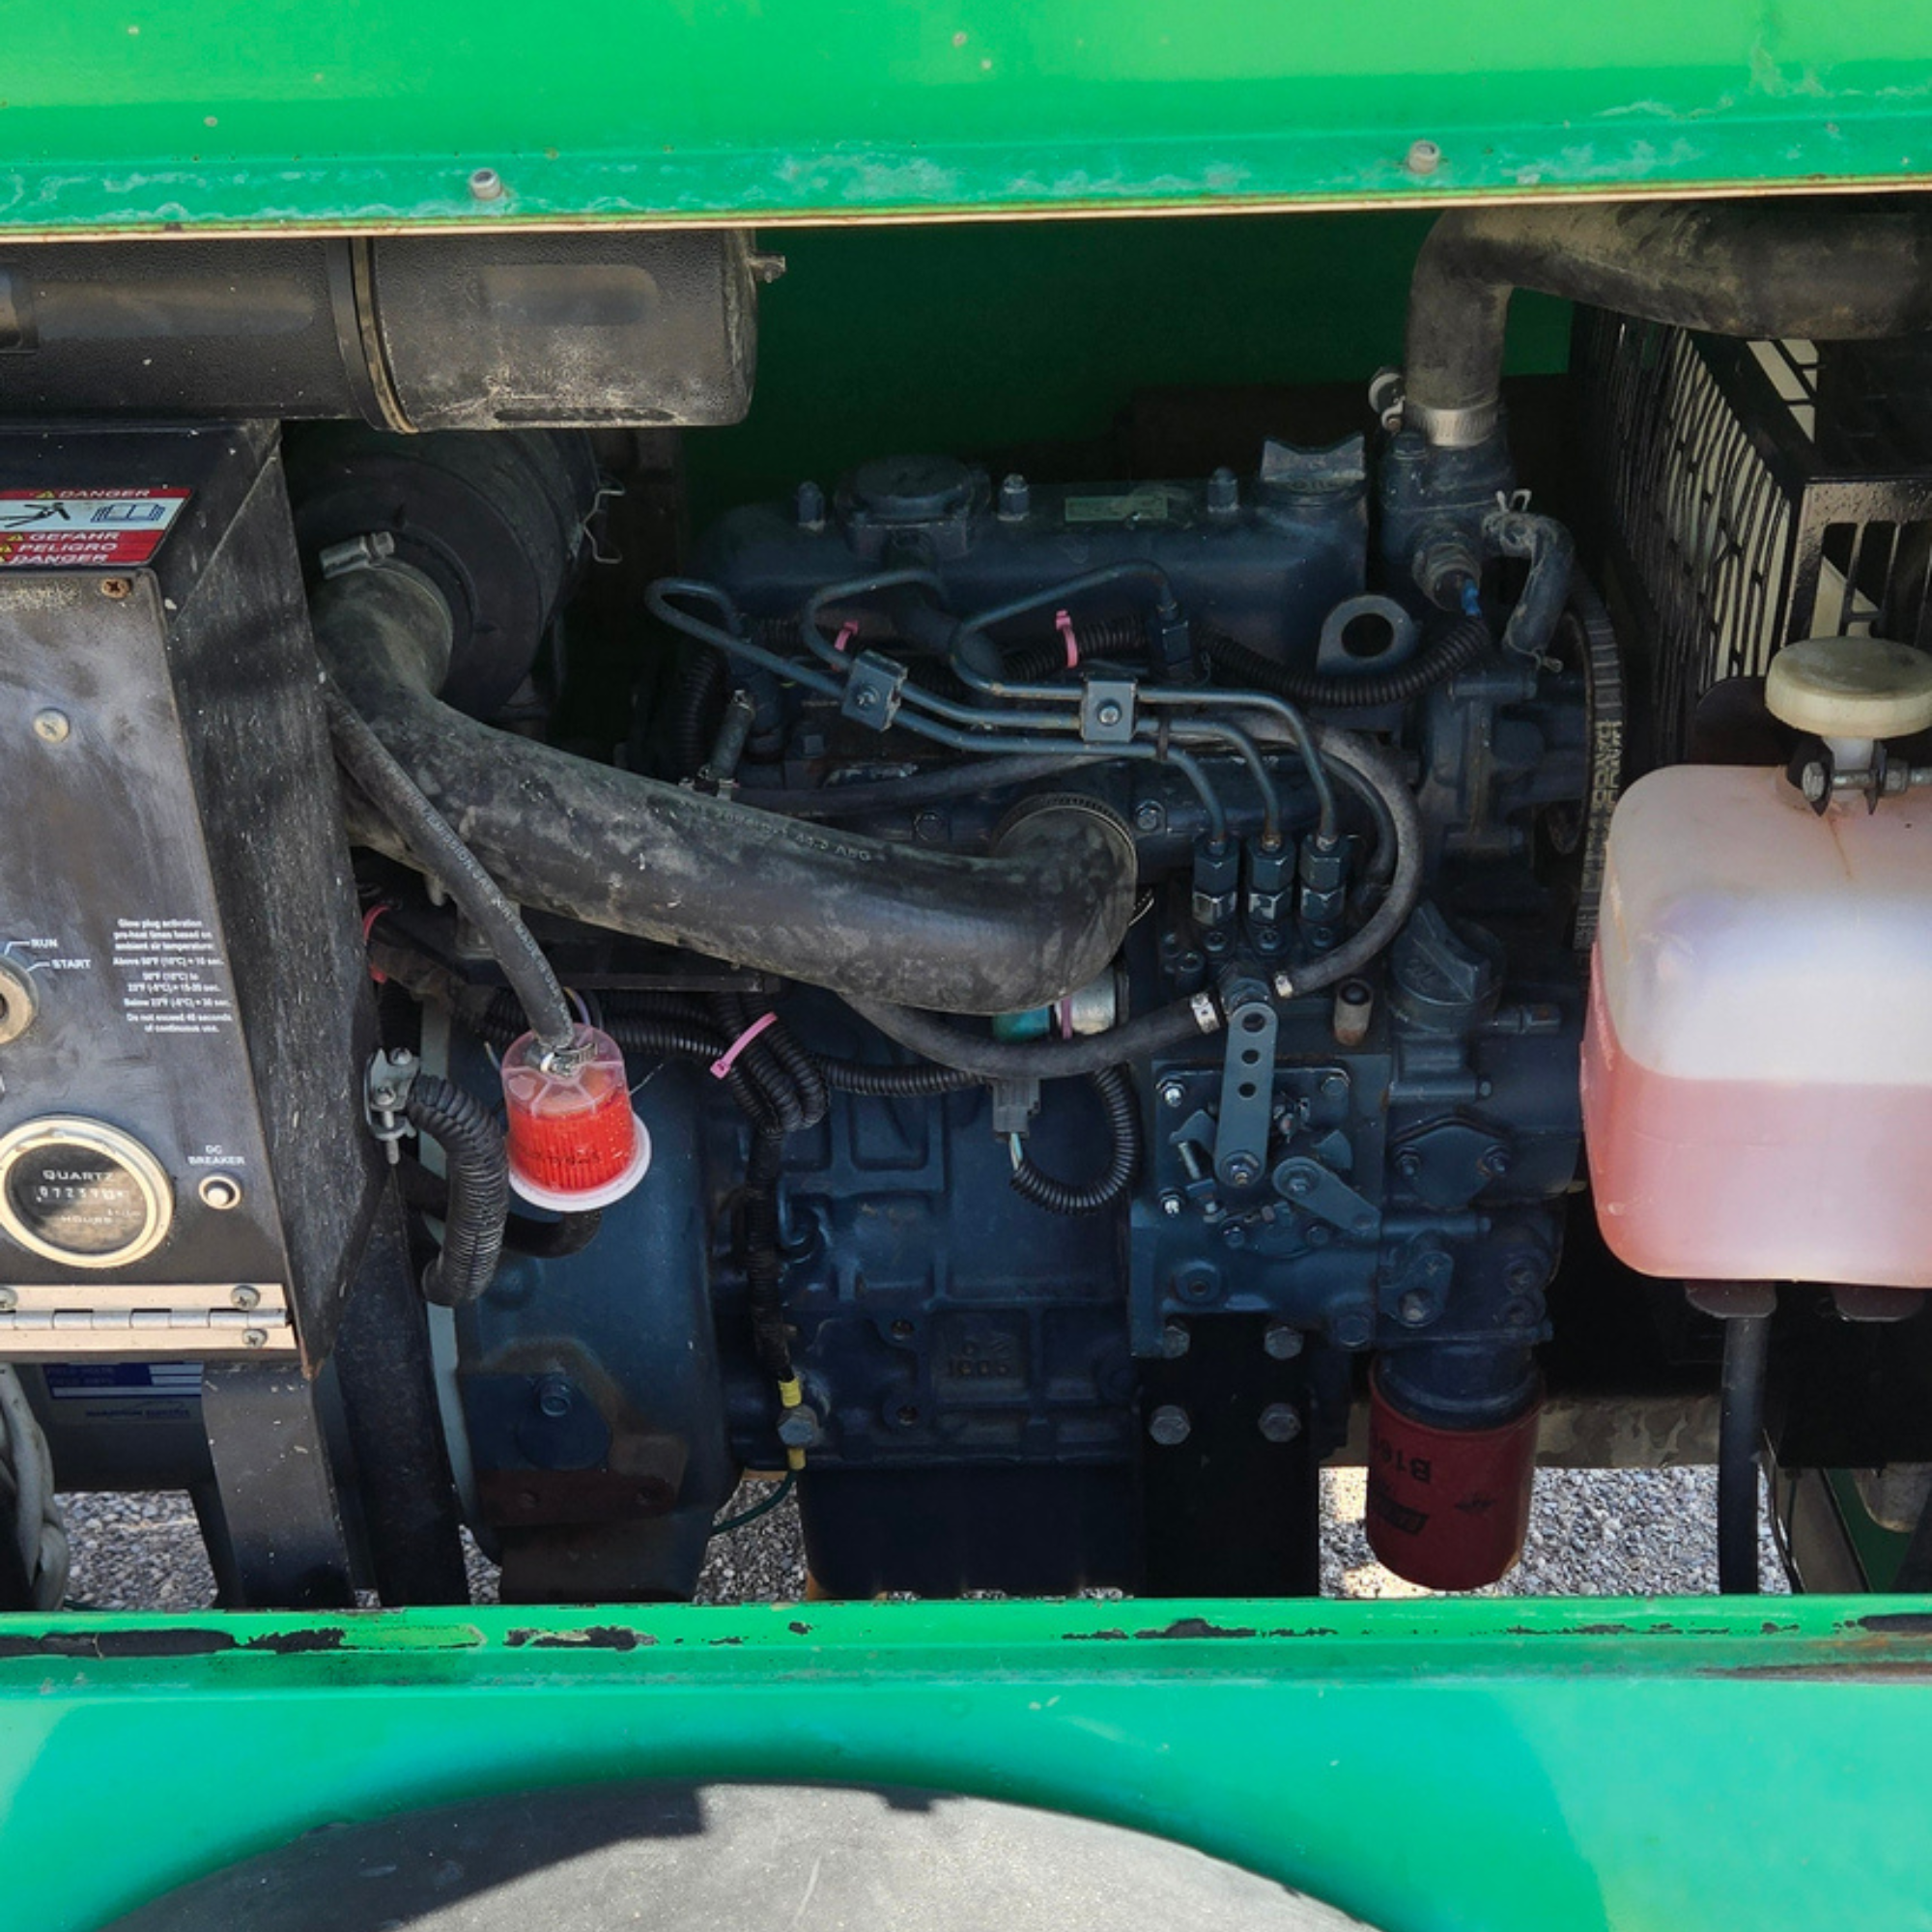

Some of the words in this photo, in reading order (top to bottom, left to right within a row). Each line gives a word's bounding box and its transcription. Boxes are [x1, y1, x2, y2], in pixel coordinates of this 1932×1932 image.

[59, 490, 151, 498] DANGER
[29, 532, 121, 541] GEFAHR
[17, 543, 118, 552] PELIGRO
[9, 554, 109, 564] DANGER
[31, 938, 58, 949] RUN
[51, 958, 92, 969] START
[187, 1155, 245, 1166] BREAKER
[43, 1170, 115, 1181] QUARTZ
